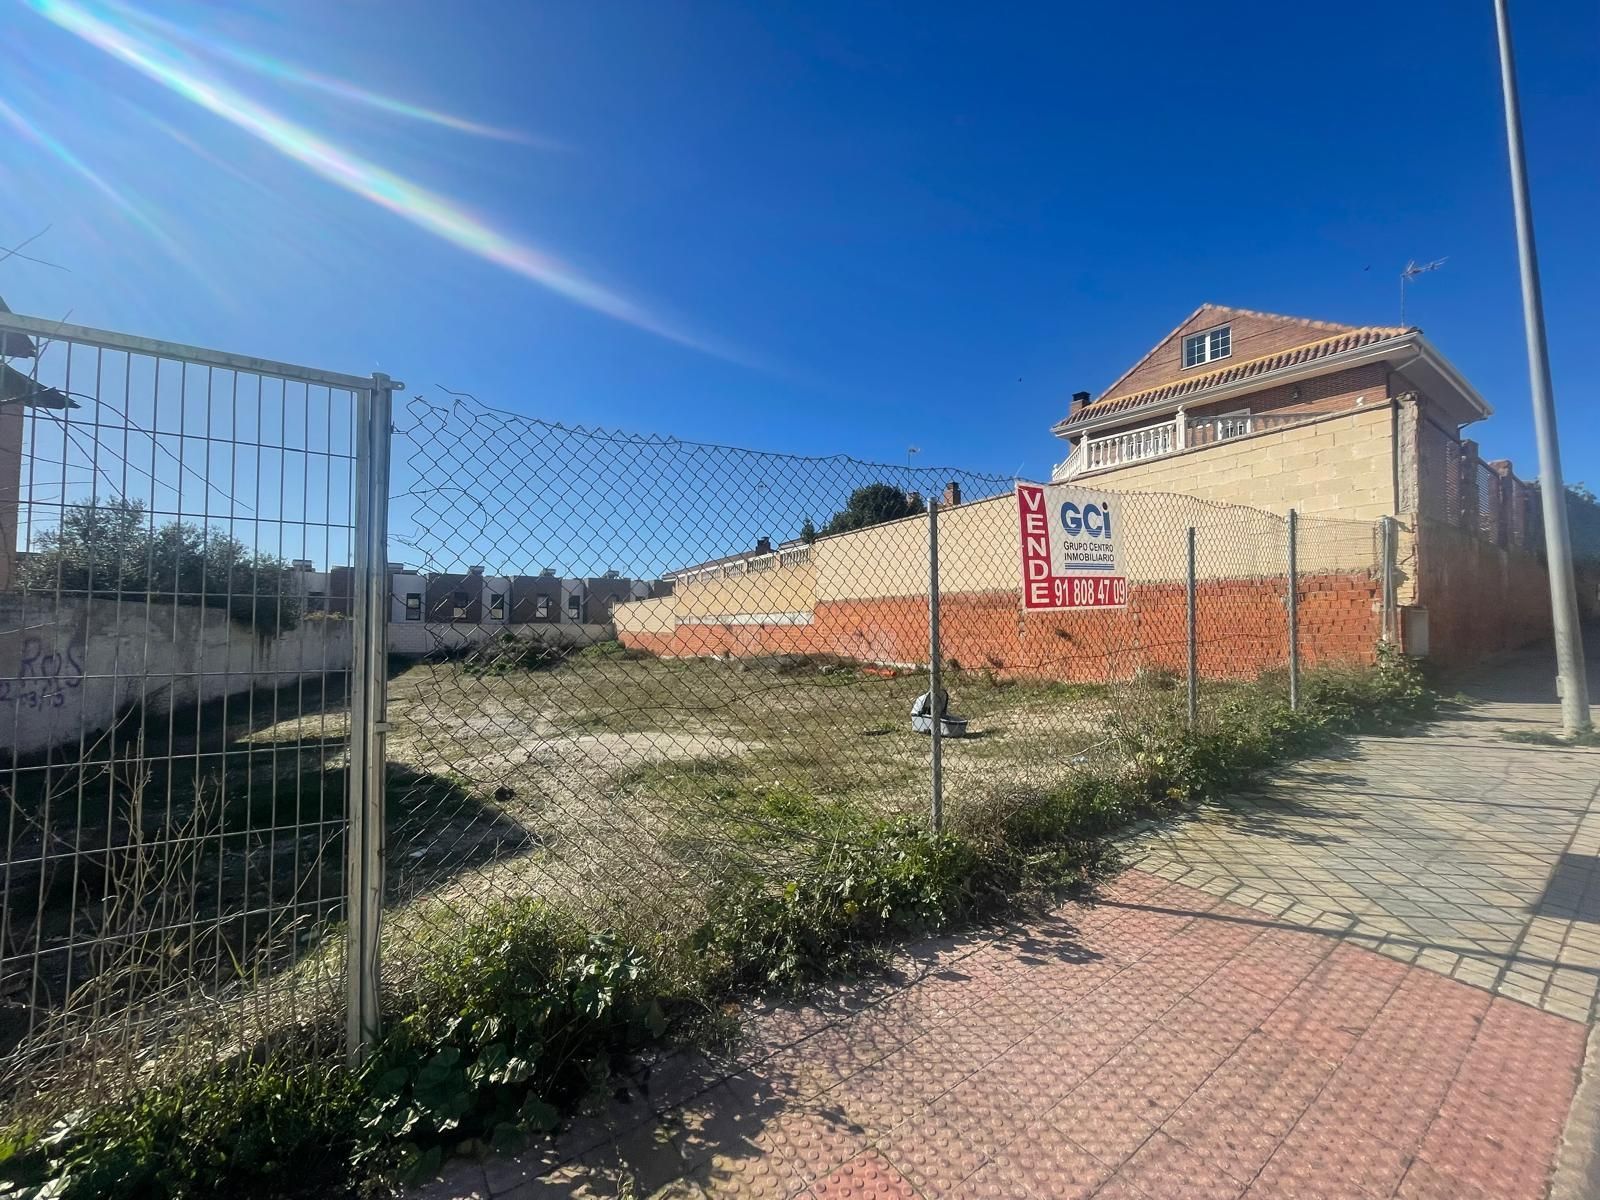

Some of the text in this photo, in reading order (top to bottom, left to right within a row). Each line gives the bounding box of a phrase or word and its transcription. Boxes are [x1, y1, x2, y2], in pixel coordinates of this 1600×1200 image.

[1022, 489, 1050, 604] VENDE
[1063, 541, 1114, 552] GRUPO CENTRO
[1064, 553, 1115, 562] INMOBILIARIO
[1054, 579, 1125, 606] 91 808 47 09
